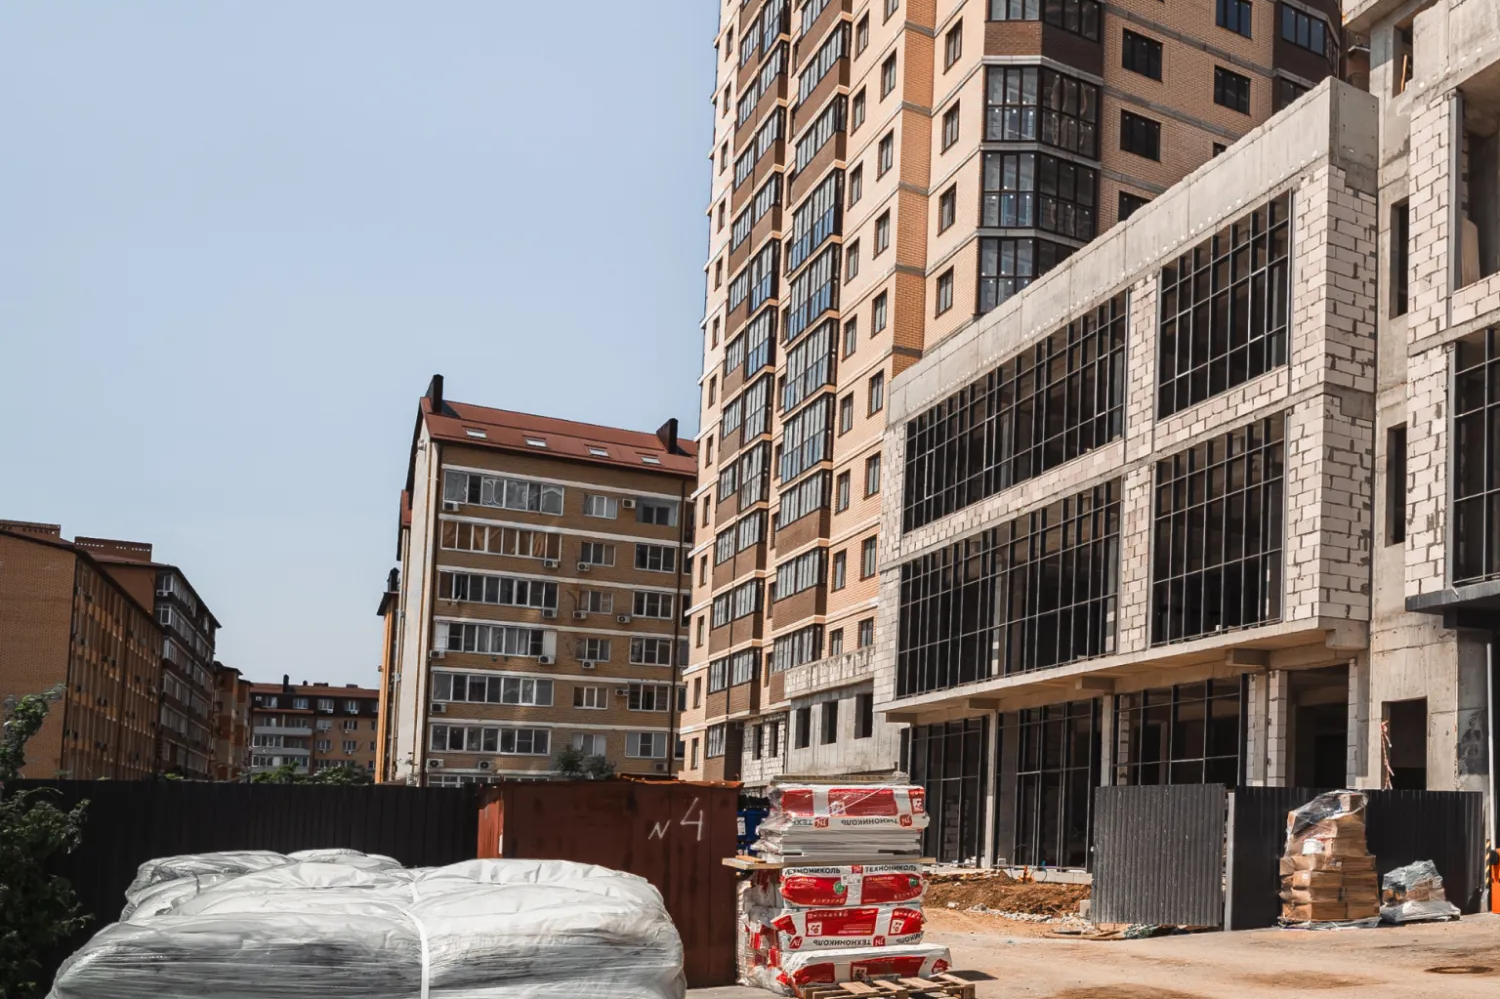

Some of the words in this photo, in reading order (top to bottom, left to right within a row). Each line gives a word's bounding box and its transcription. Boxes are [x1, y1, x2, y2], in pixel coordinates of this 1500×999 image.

[680, 797, 703, 841] 4
[865, 864, 917, 873] ТЕХНОНИКОЛЬ
[813, 938, 871, 947] ТЕХНОНИКОЛЬ
